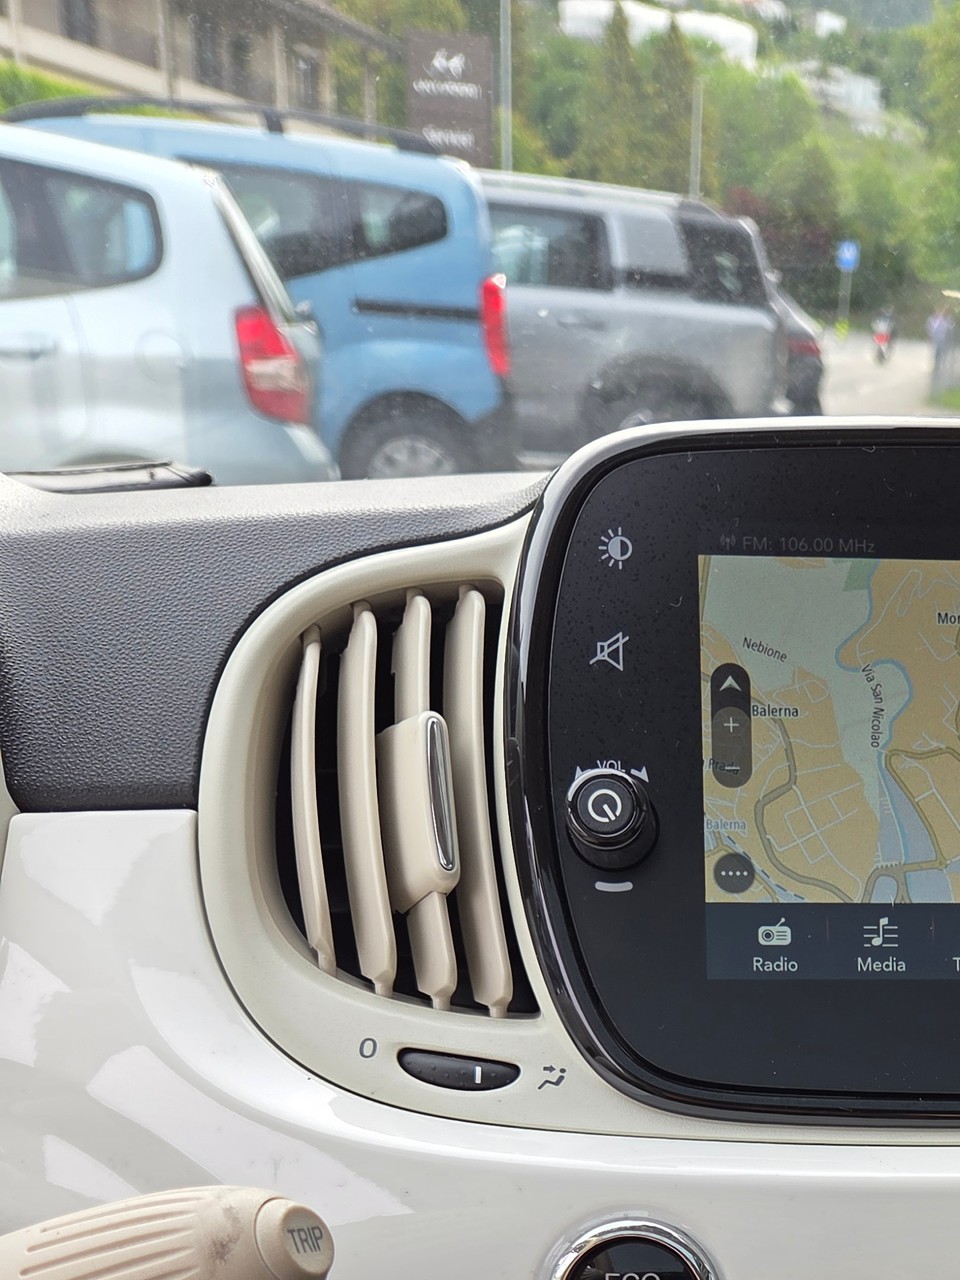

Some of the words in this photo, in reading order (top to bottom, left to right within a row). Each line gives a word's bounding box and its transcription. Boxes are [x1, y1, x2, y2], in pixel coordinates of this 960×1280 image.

[742, 536, 772, 551] FM:
[778, 537, 834, 552] 106.00
[838, 538, 876, 553] MHz
[742, 636, 788, 663] Nebione
[861, 663, 876, 683] Via
[870, 683, 883, 704] San
[751, 703, 799, 718] Balerna
[870, 706, 886, 749] Nicolao
[596, 759, 626, 773] VOL
[706, 818, 747, 831] Balerna
[752, 957, 799, 972] Radio
[856, 957, 906, 972] Media
[287, 1224, 324, 1256] TRIP
